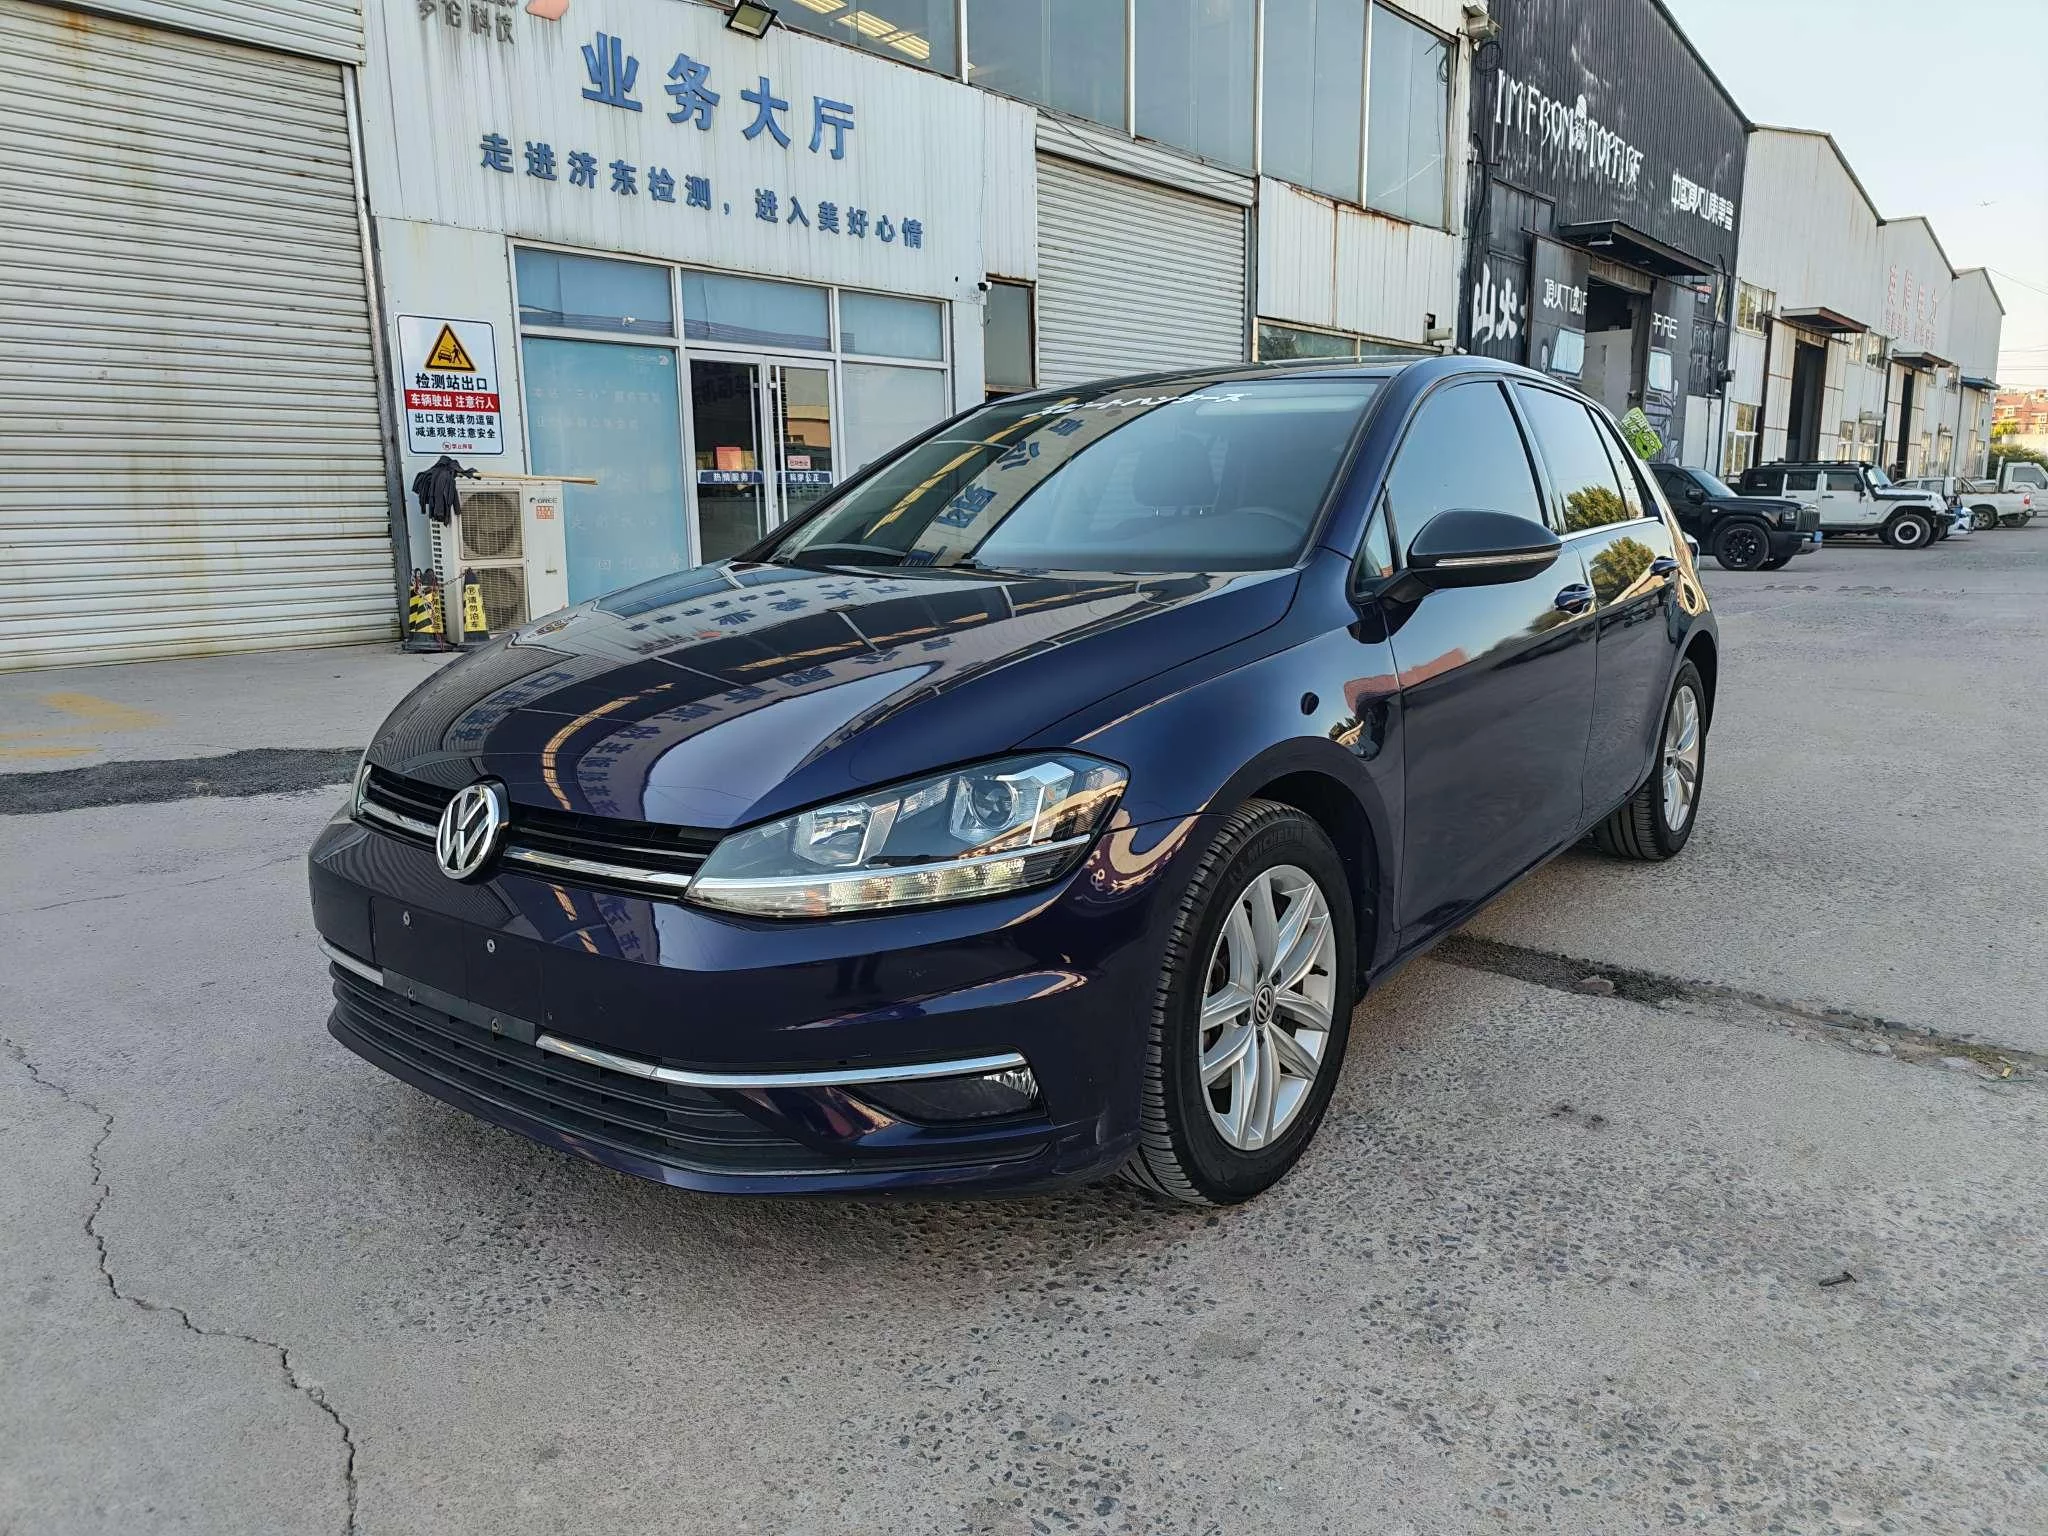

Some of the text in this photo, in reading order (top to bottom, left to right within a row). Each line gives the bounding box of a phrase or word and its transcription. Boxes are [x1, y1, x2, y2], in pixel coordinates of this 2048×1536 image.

[581, 32, 855, 160] 业务大厅
[415, 373, 488, 391] 检测站出口
[411, 393, 495, 409] 车辆驶出 注意行人
[415, 427, 496, 438] 减速观察注意安全
